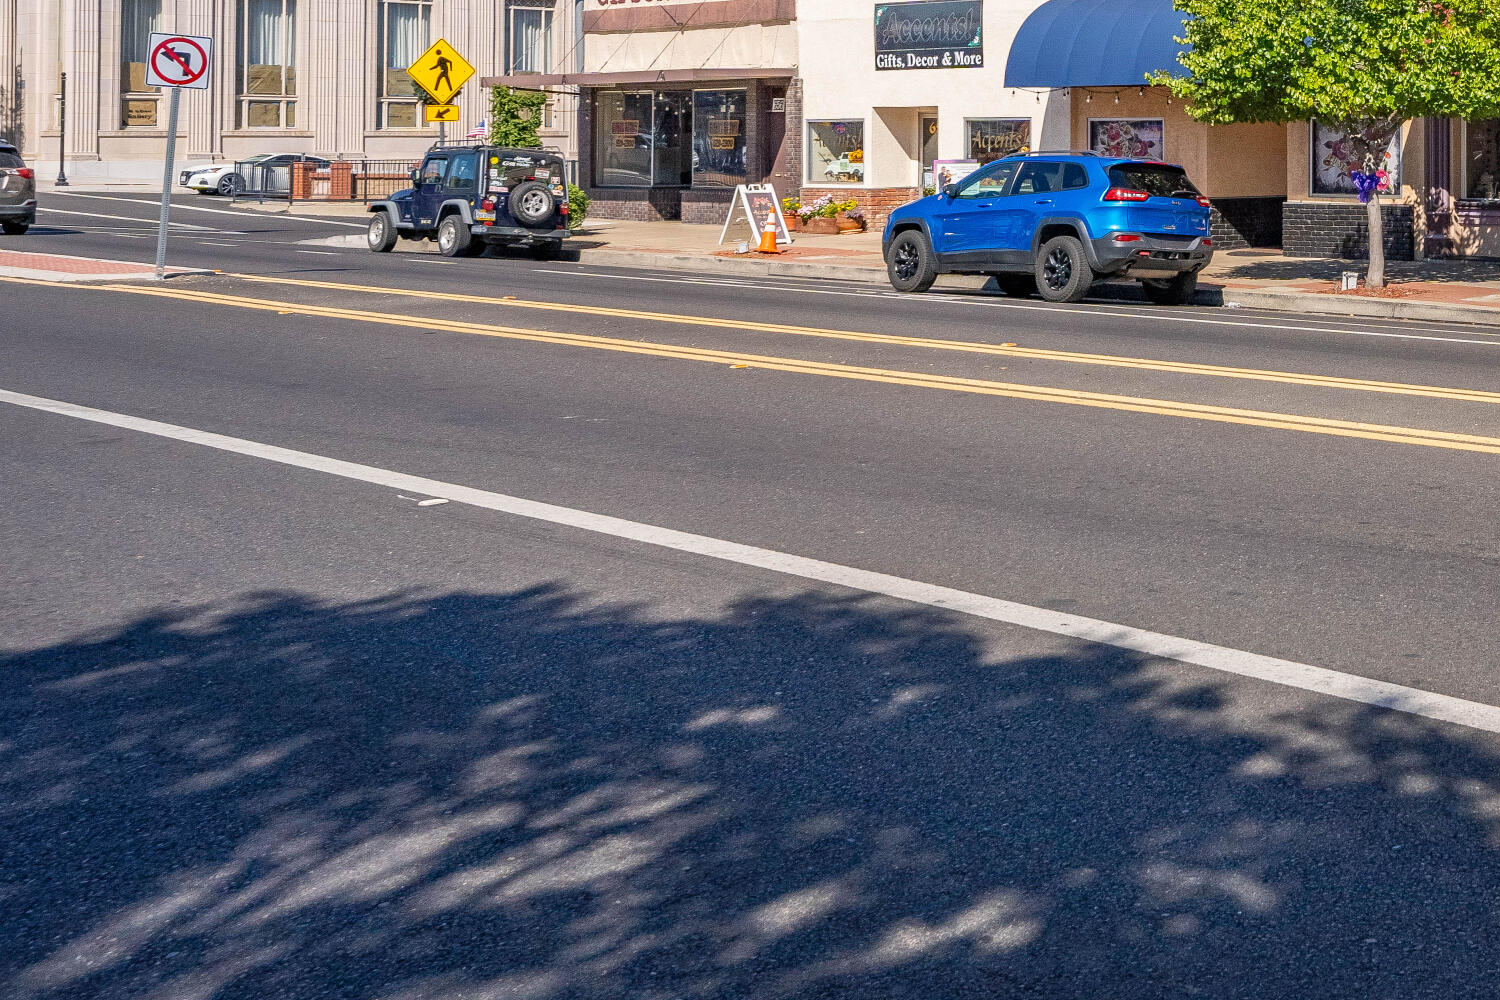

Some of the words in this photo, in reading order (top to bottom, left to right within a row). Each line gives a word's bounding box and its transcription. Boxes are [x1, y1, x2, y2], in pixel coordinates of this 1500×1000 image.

[882, 8, 974, 44] Accents!
[876, 54, 905, 69] Gifts,
[906, 53, 938, 67] Decor
[941, 51, 953, 66] &
[954, 51, 982, 66] More
[971, 122, 1029, 150] Accents!
